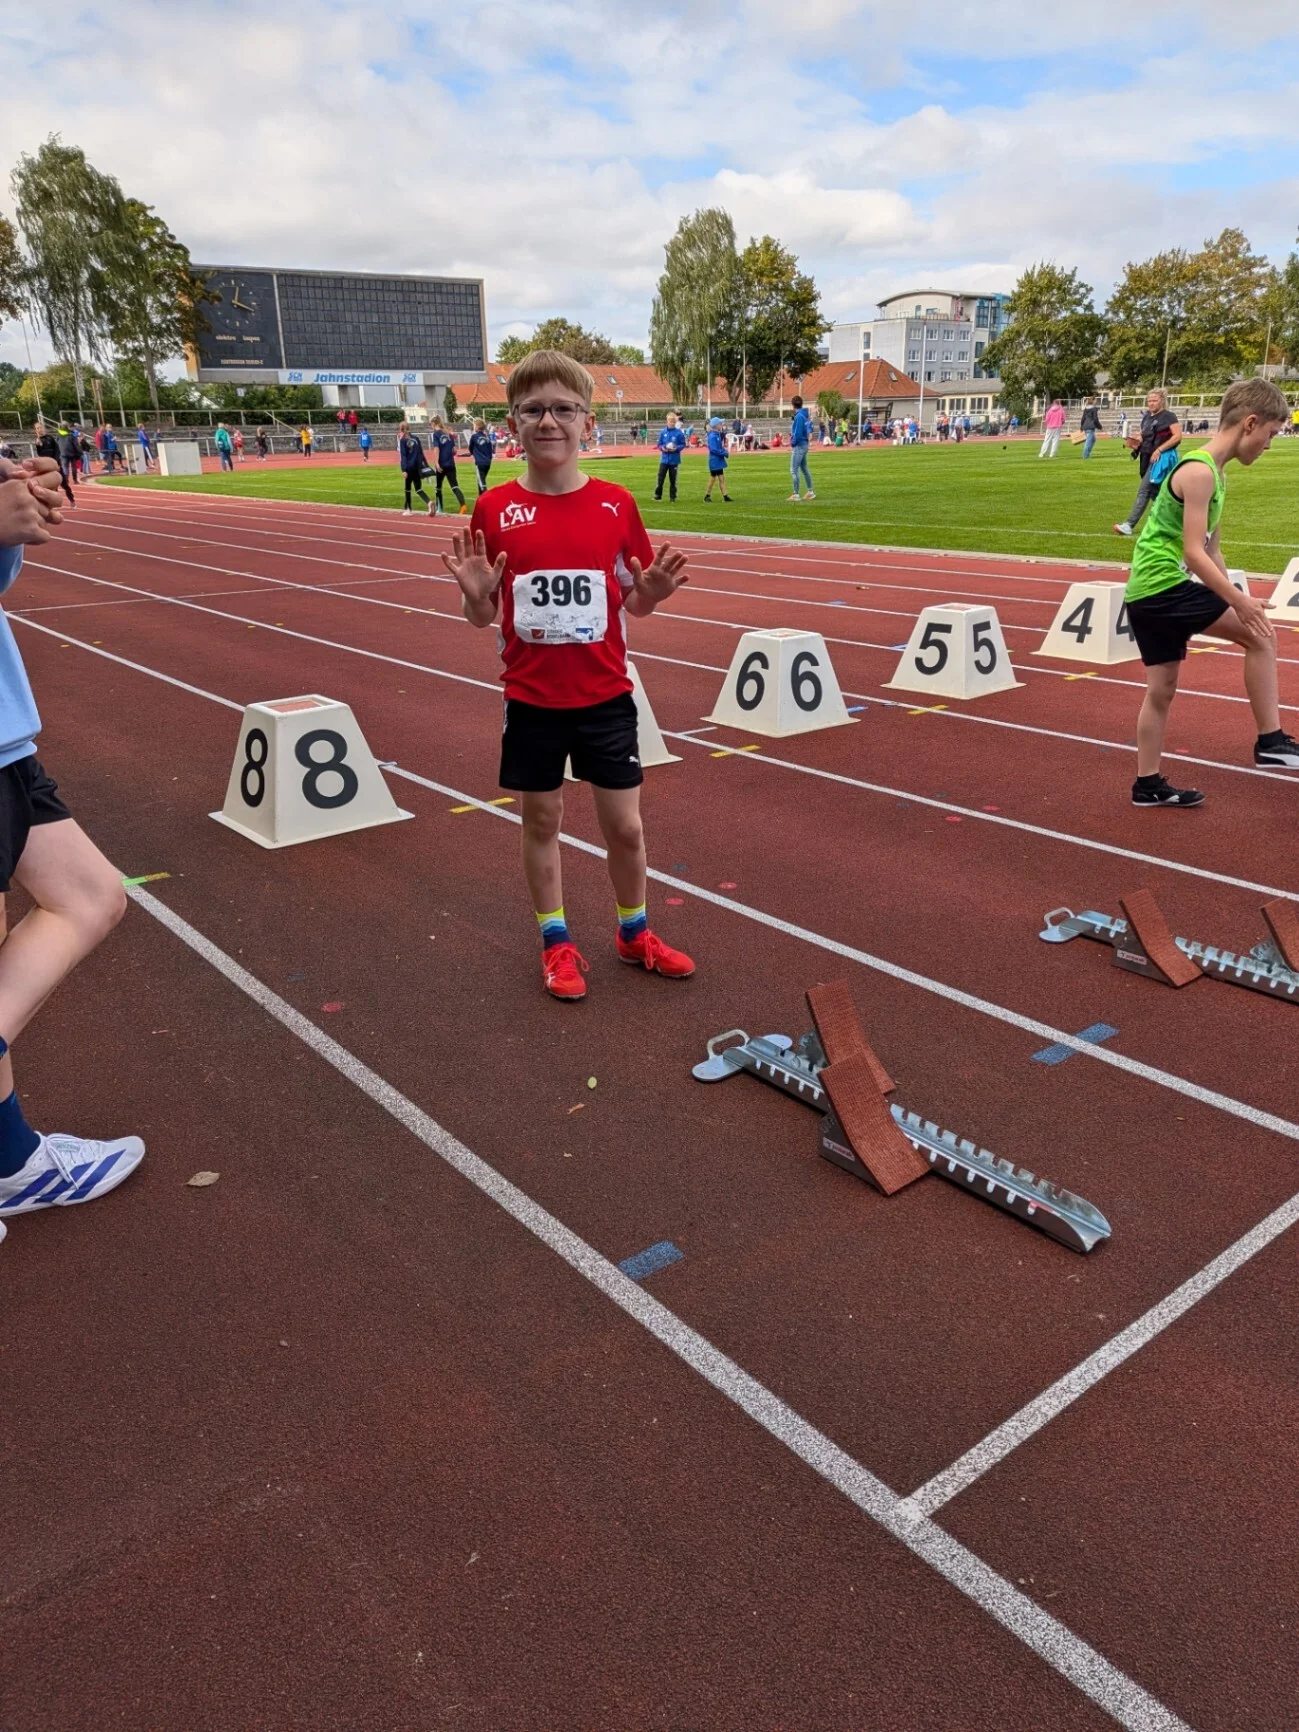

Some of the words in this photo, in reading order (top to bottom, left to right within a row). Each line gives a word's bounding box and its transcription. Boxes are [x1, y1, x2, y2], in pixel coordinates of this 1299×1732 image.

[313, 372, 391, 383] Jahnstadion
[499, 506, 537, 529] LAV
[531, 574, 592, 607] 396
[1061, 597, 1095, 643] 4
[914, 622, 952, 675] 5
[972, 620, 997, 675] 5
[735, 651, 770, 711] 6
[790, 651, 823, 712] 6
[240, 728, 268, 808] 8
[294, 729, 359, 809] 8
